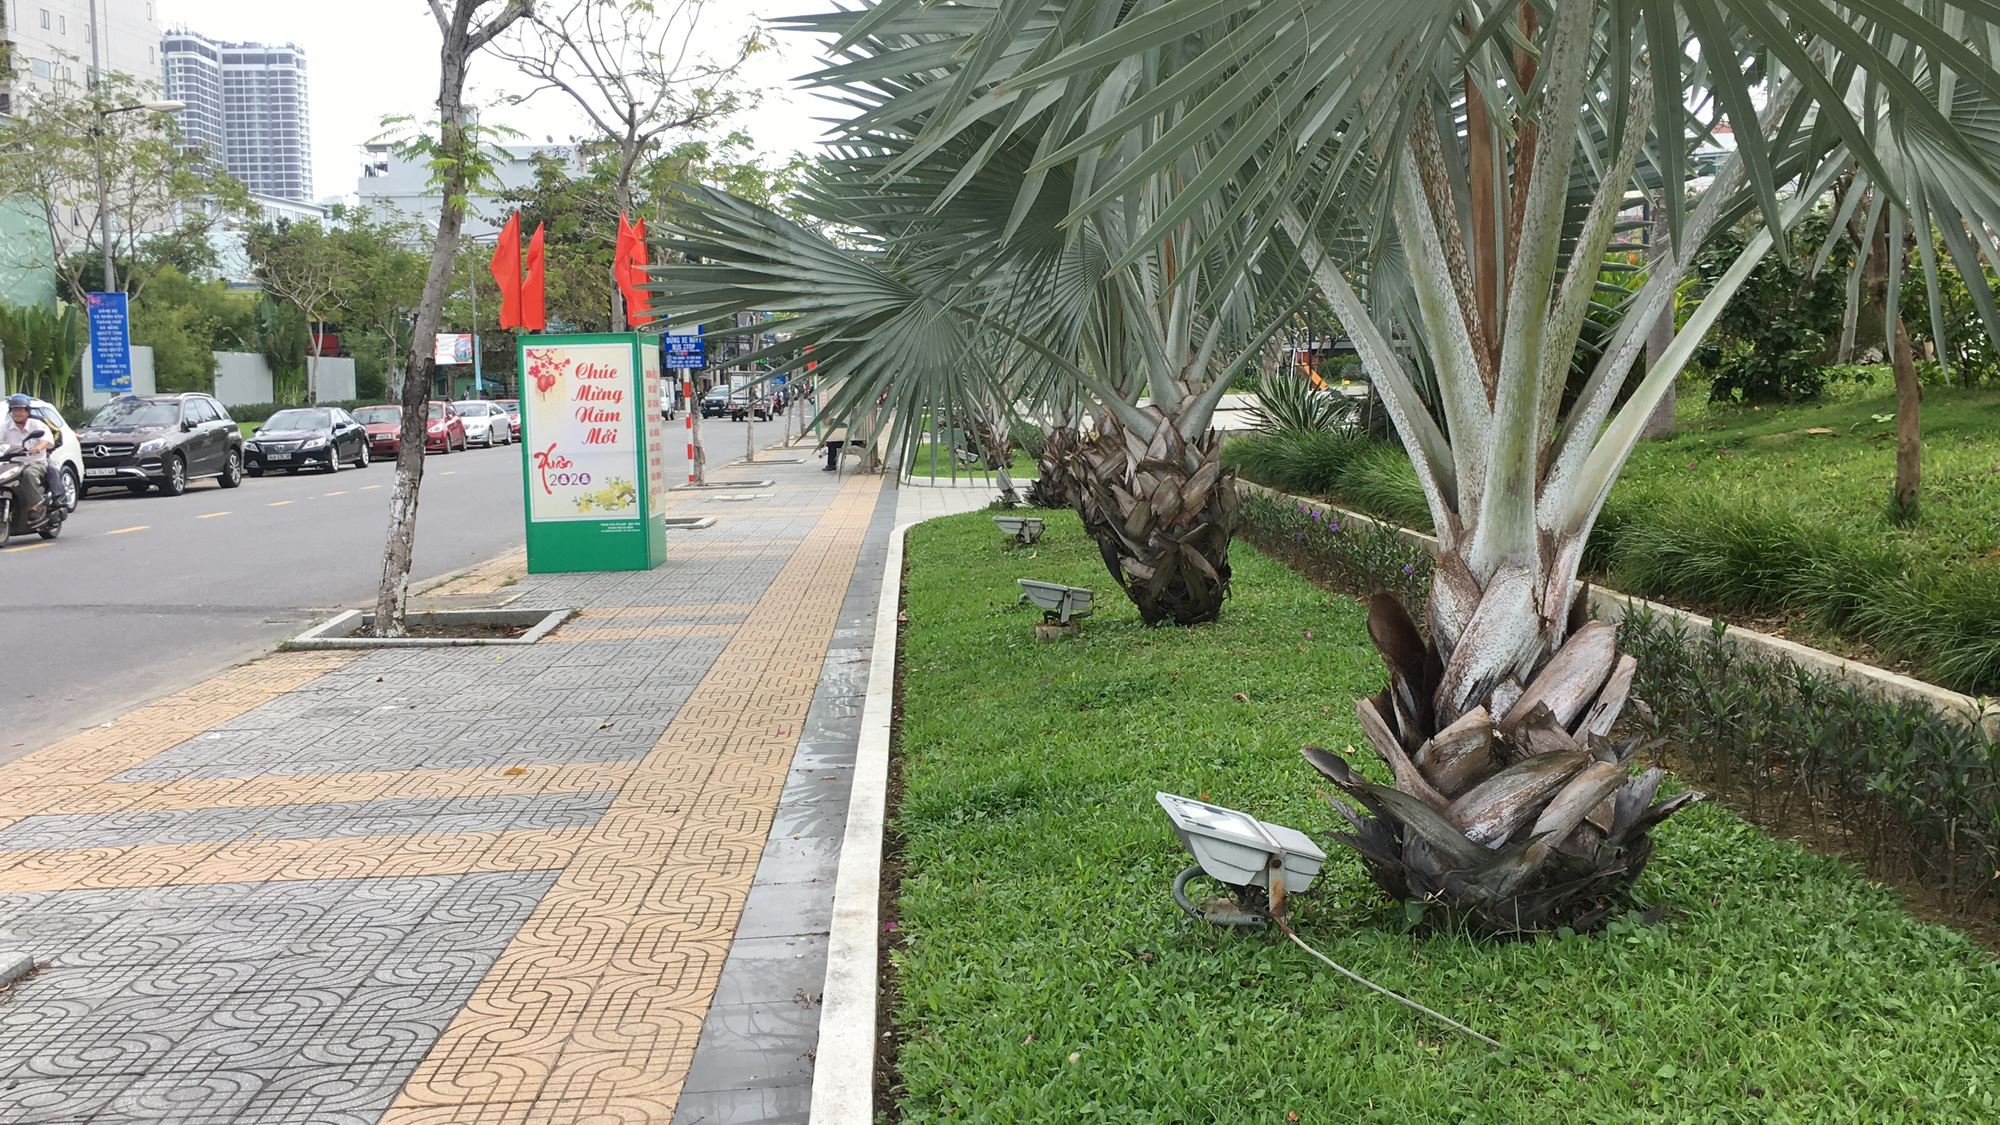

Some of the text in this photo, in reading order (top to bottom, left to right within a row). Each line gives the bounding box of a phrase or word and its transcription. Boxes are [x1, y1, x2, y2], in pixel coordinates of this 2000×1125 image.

[575, 362, 618, 380] Chúc
[572, 384, 624, 404] Mừng
[574, 406, 622, 423] Năm
[582, 428, 618, 445] Mới
[533, 443, 573, 495] Xuân
